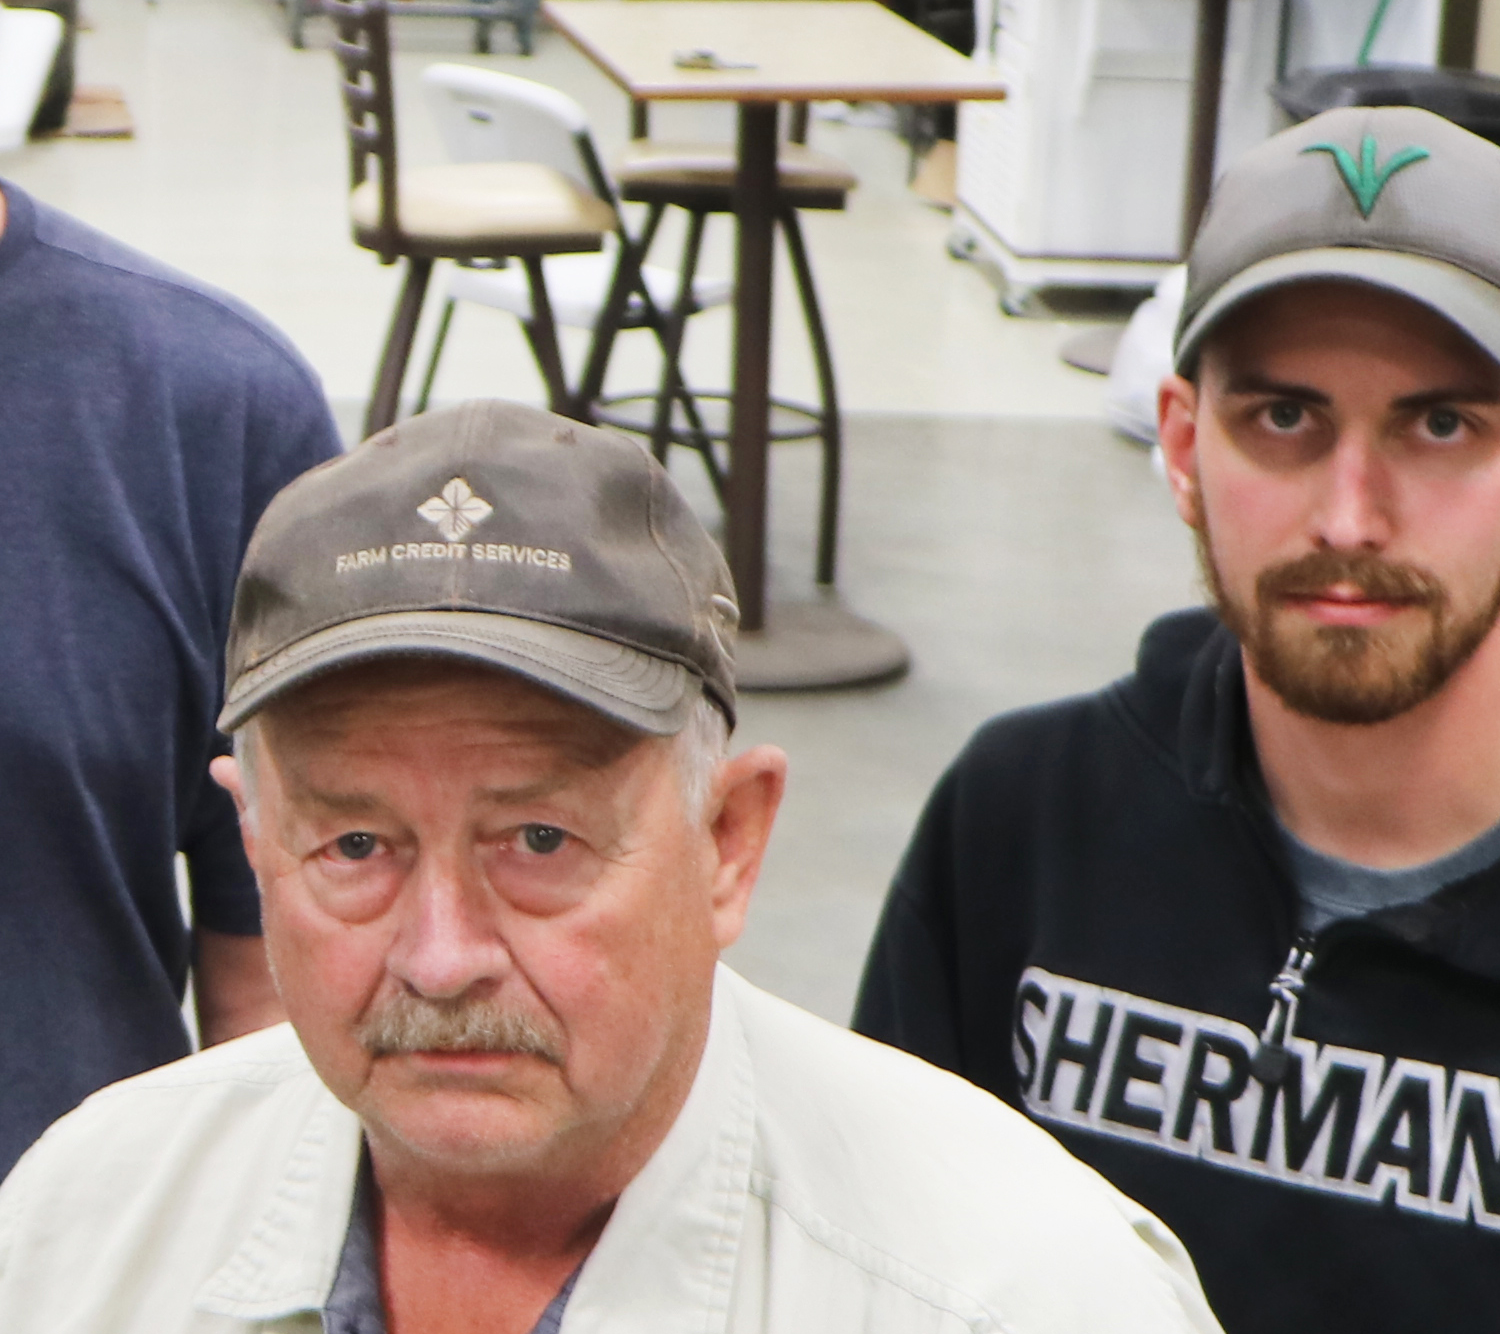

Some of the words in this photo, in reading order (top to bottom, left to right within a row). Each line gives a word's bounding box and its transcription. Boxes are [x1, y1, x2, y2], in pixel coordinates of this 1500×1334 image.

[335, 546, 387, 573] FARM
[391, 542, 467, 561] CREDIT
[471, 543, 573, 571] SERVICES
